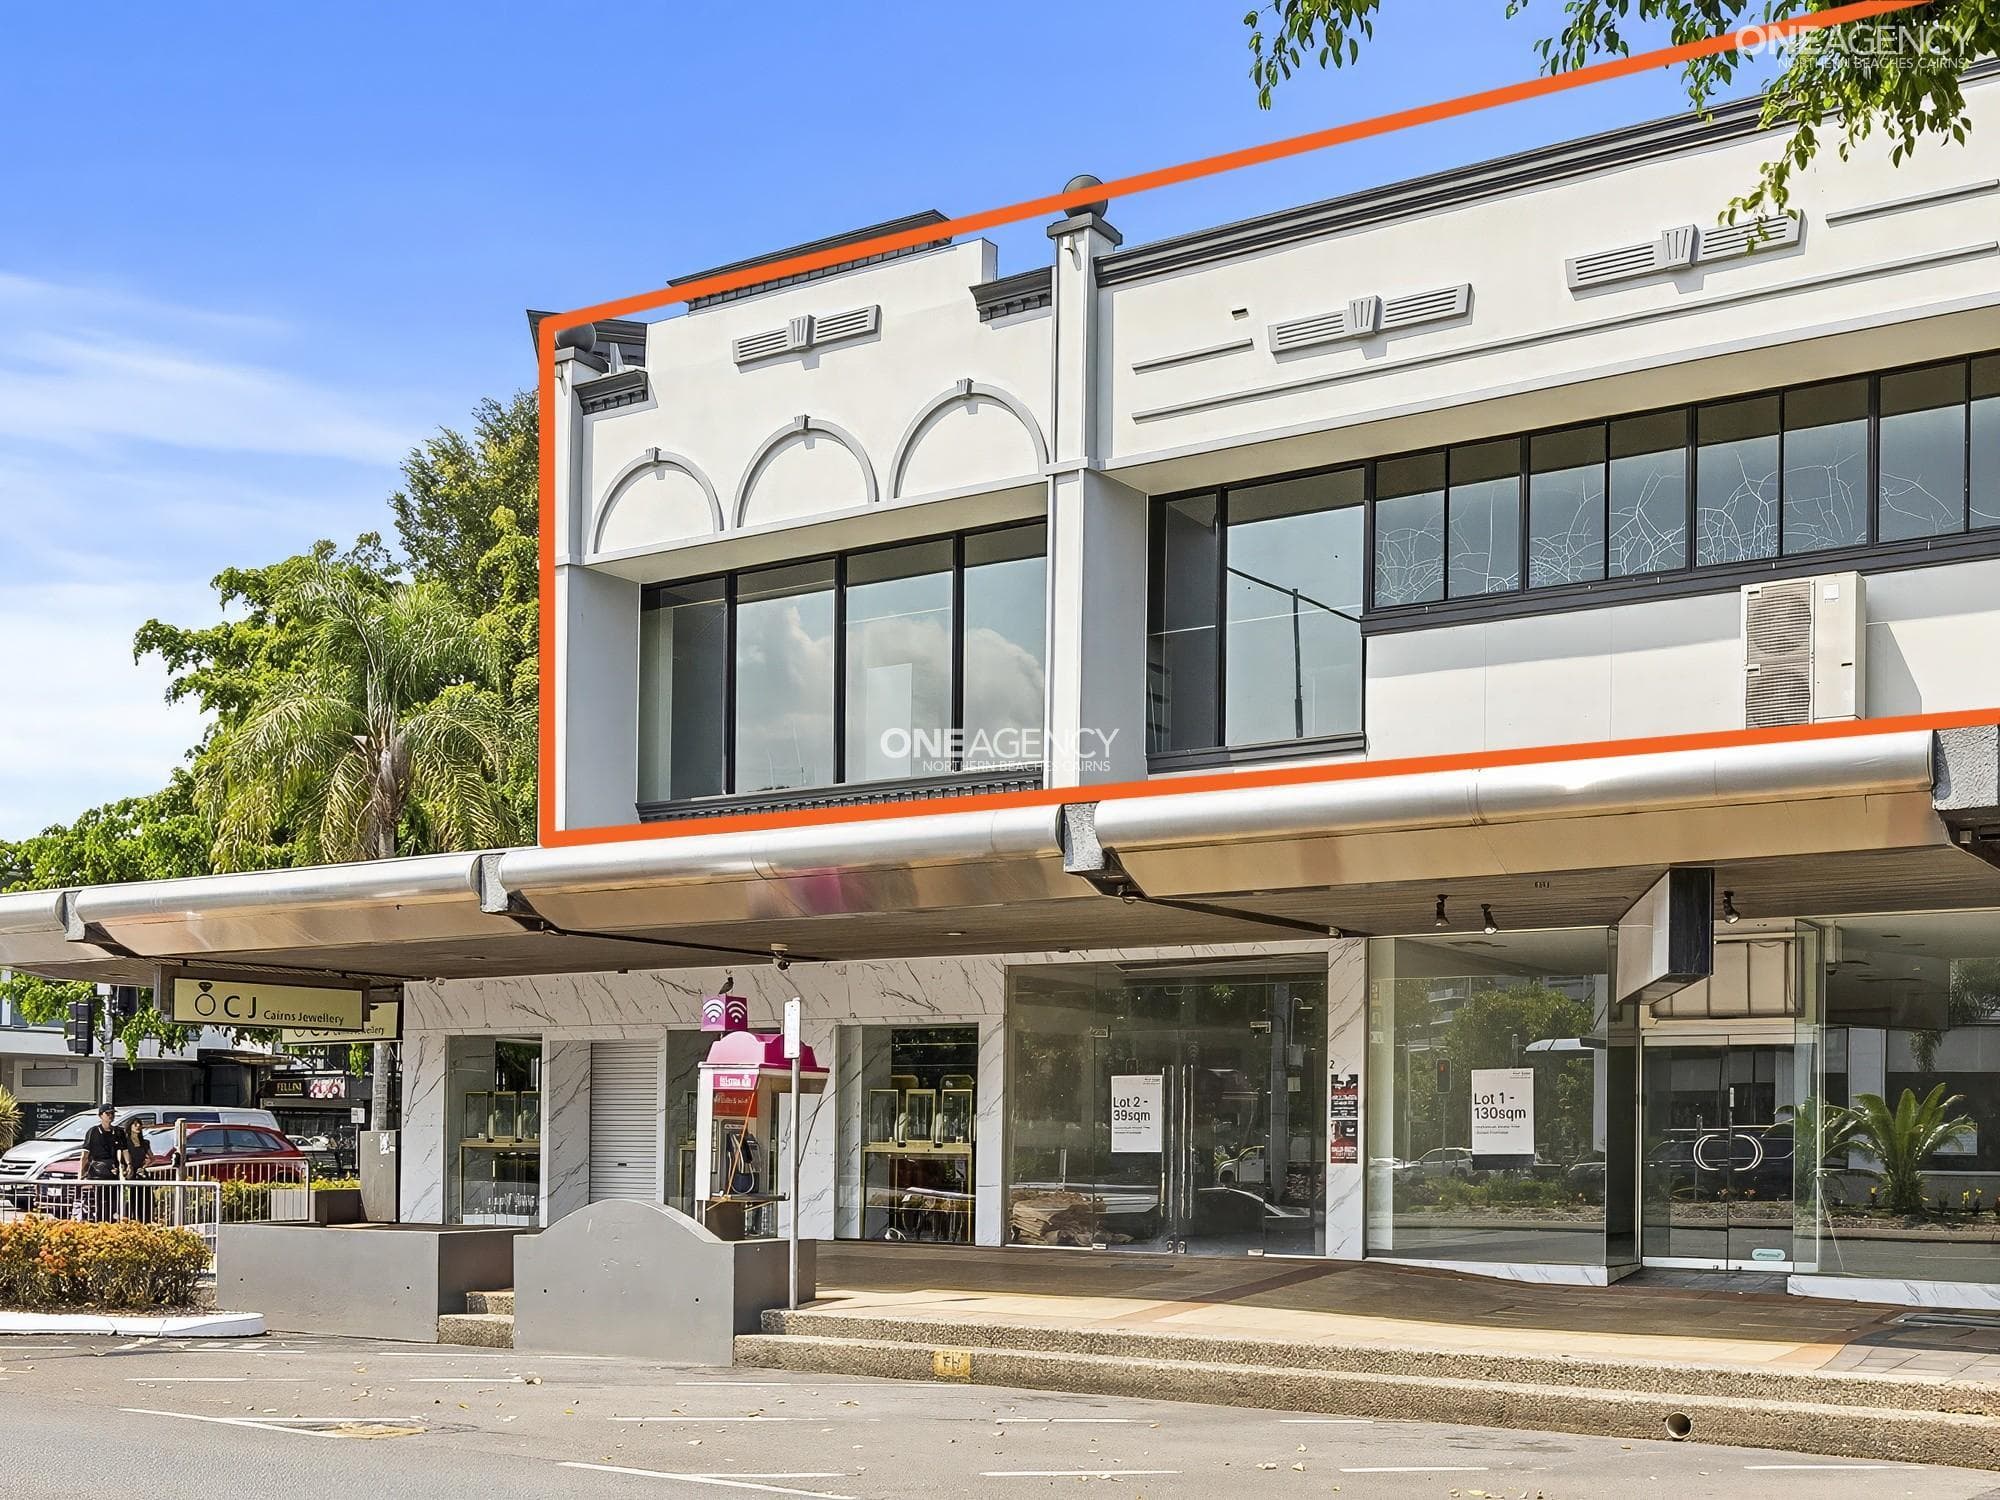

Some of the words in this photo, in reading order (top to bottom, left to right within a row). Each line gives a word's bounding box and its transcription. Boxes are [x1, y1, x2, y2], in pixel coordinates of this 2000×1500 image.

[263, 1009, 297, 1022] Cairns
[298, 1012, 345, 1026] Jewellery
[1329, 1060, 1335, 1069] 2
[1113, 1096, 1131, 1108] Lot
[1133, 1096, 1141, 1108] 2
[1474, 1093, 1494, 1104] Lot
[1499, 1092, 1504, 1104] 1
[1113, 1109, 1151, 1123] 39sqm
[1474, 1107, 1526, 1121] 130sqm
